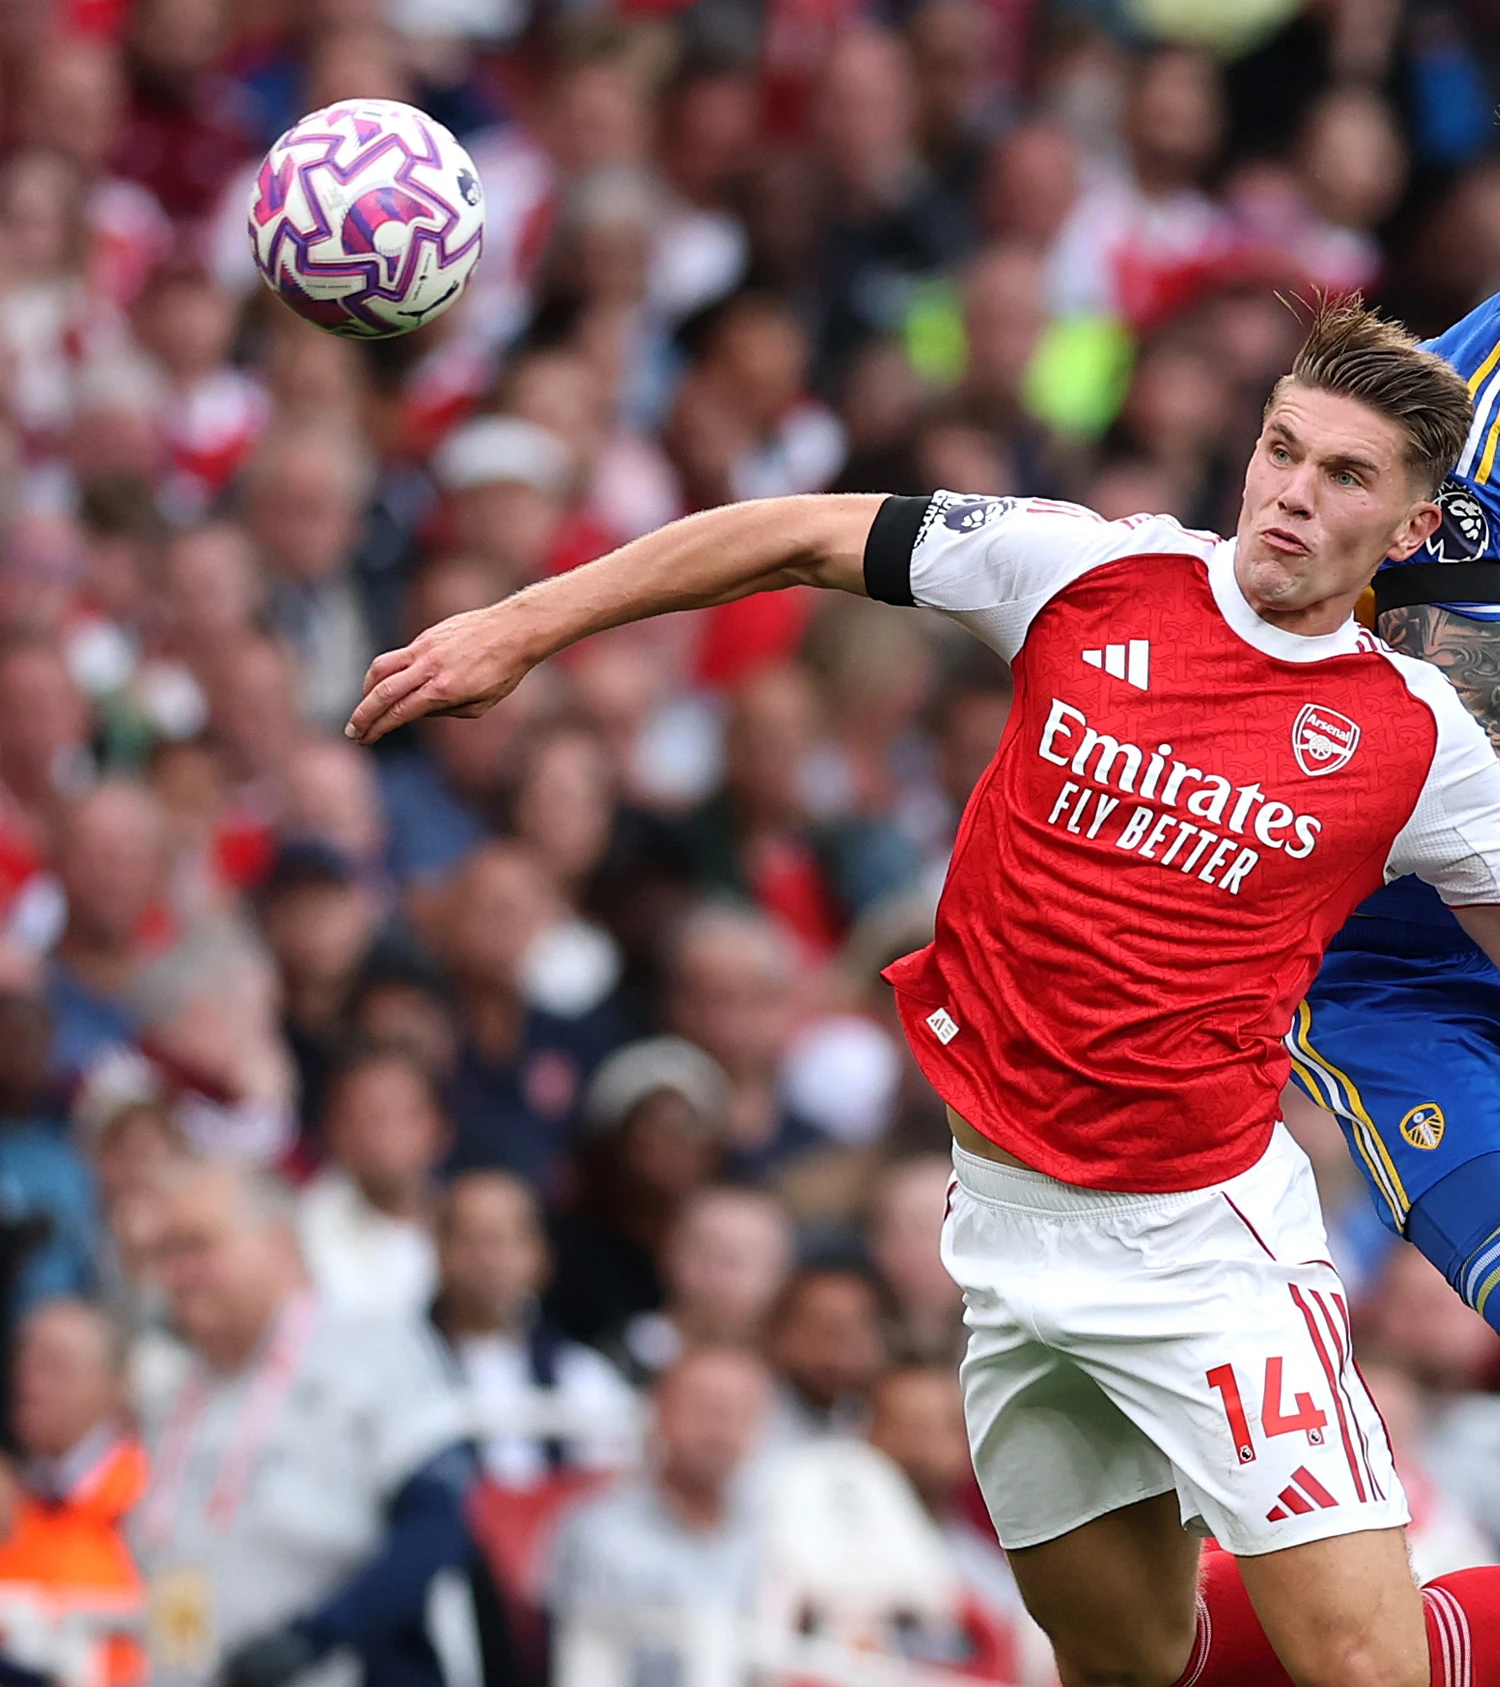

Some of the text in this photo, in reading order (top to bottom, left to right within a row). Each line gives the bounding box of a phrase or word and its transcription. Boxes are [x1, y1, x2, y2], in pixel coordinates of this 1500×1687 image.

[1038, 698, 1323, 859] Emirates
[1306, 713, 1352, 742] Arsenal
[1047, 780, 1259, 895] FLY BETTER
[1206, 1356, 1328, 1464] 14
